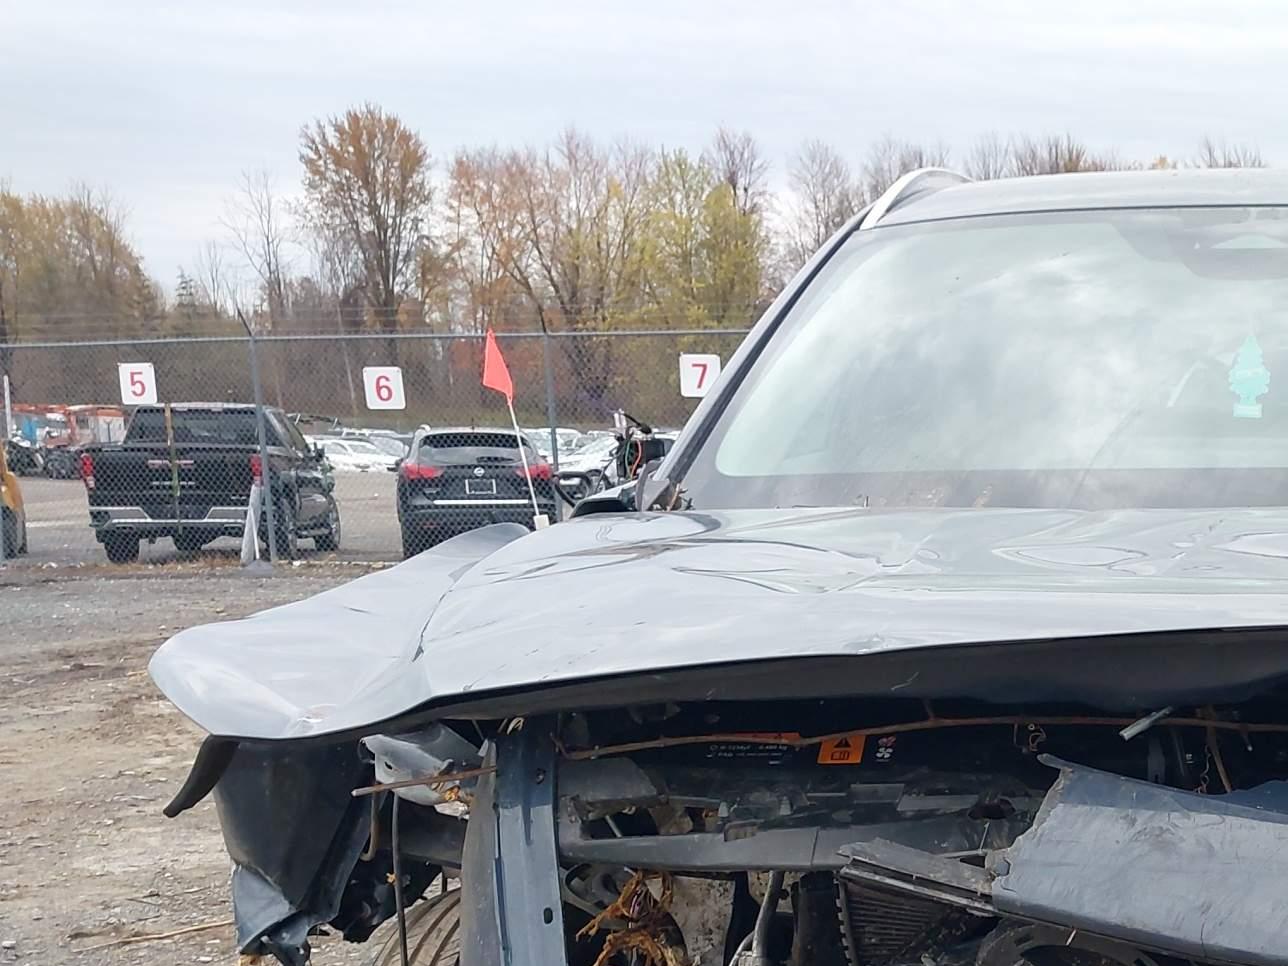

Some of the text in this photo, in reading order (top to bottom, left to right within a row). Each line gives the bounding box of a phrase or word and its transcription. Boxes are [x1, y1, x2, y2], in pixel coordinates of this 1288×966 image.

[130, 371, 146, 397] 5
[375, 375, 393, 402] 6
[691, 363, 708, 389] 7
